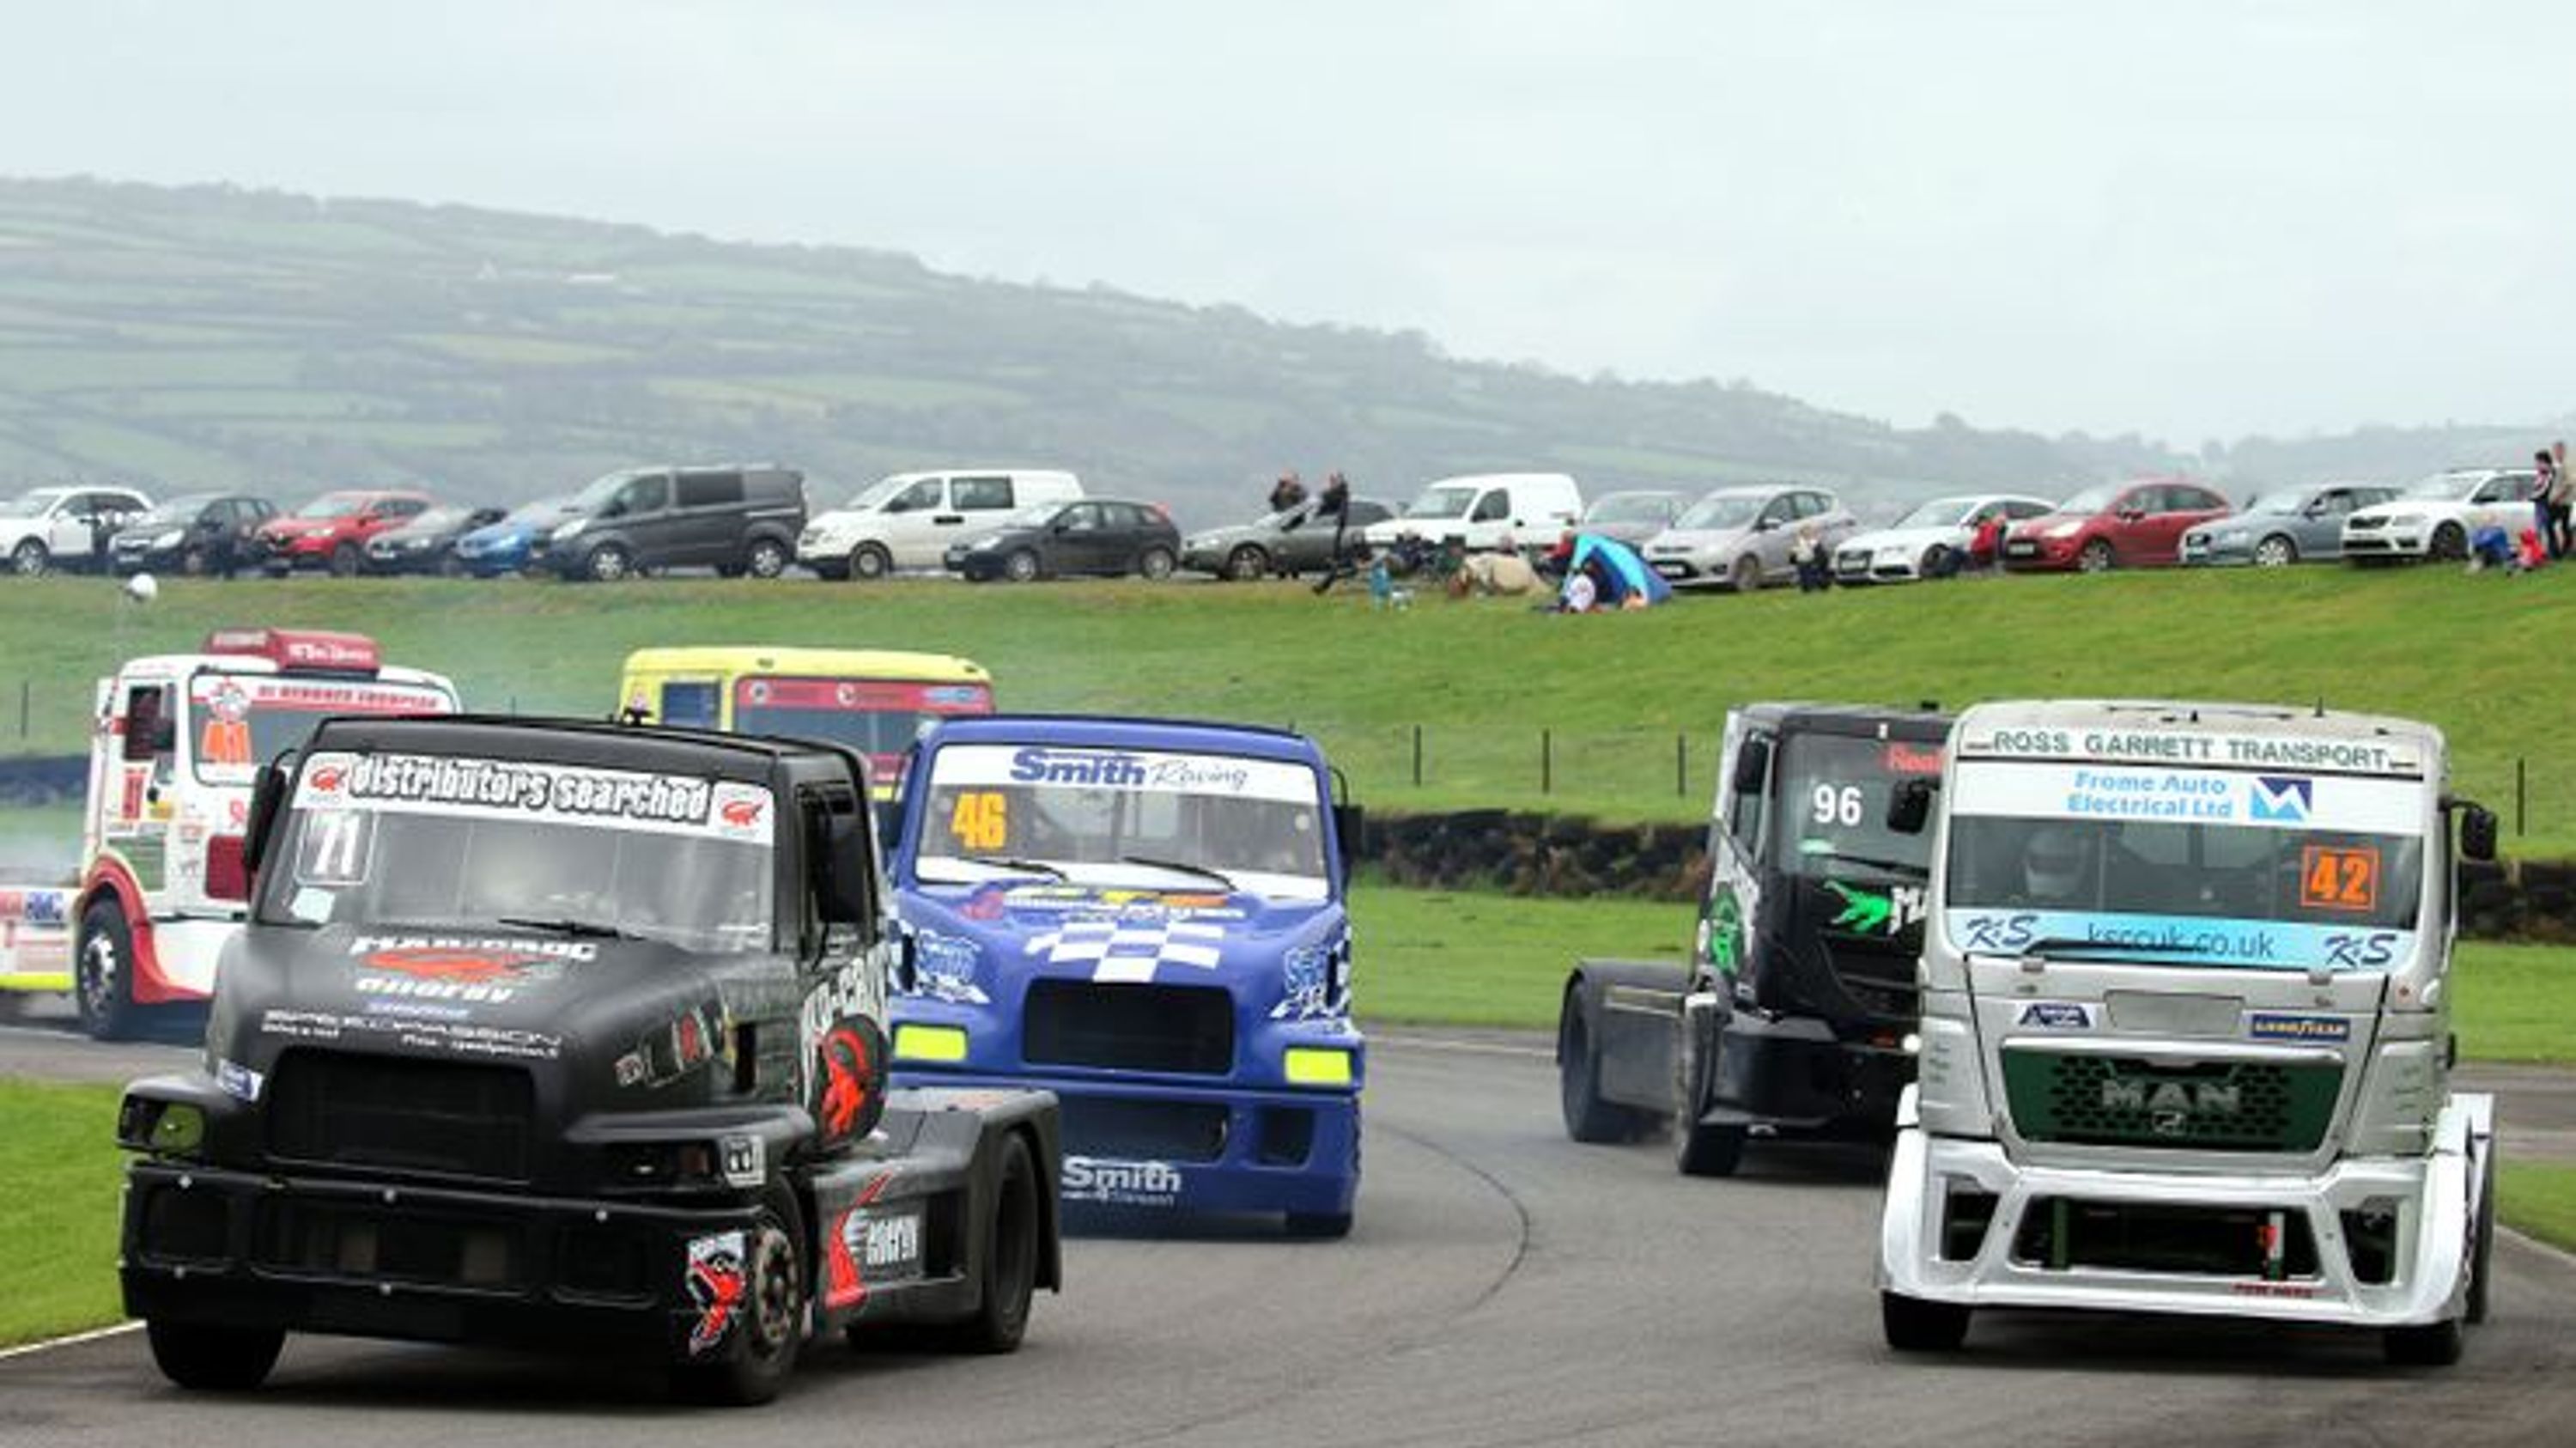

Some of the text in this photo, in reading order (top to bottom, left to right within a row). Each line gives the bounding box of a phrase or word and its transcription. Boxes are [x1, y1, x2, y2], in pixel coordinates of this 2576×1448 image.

[1010, 747, 1249, 790] Smith Racing
[1993, 730, 2387, 767] ROSS GARRETT TRANSPORT
[345, 751, 711, 824] distributors searched
[2074, 771, 2227, 794] Frome Auto
[951, 792, 1006, 849] 46
[1813, 783, 1862, 826] 96
[2067, 794, 2234, 818] Electrical Ltd
[312, 812, 360, 876] 71
[2310, 854, 2369, 902] 42
[2087, 922, 2275, 960] ksccukco.uk
[2103, 1078, 2239, 1113] MAN
[1060, 1155, 1181, 1192] Smith
